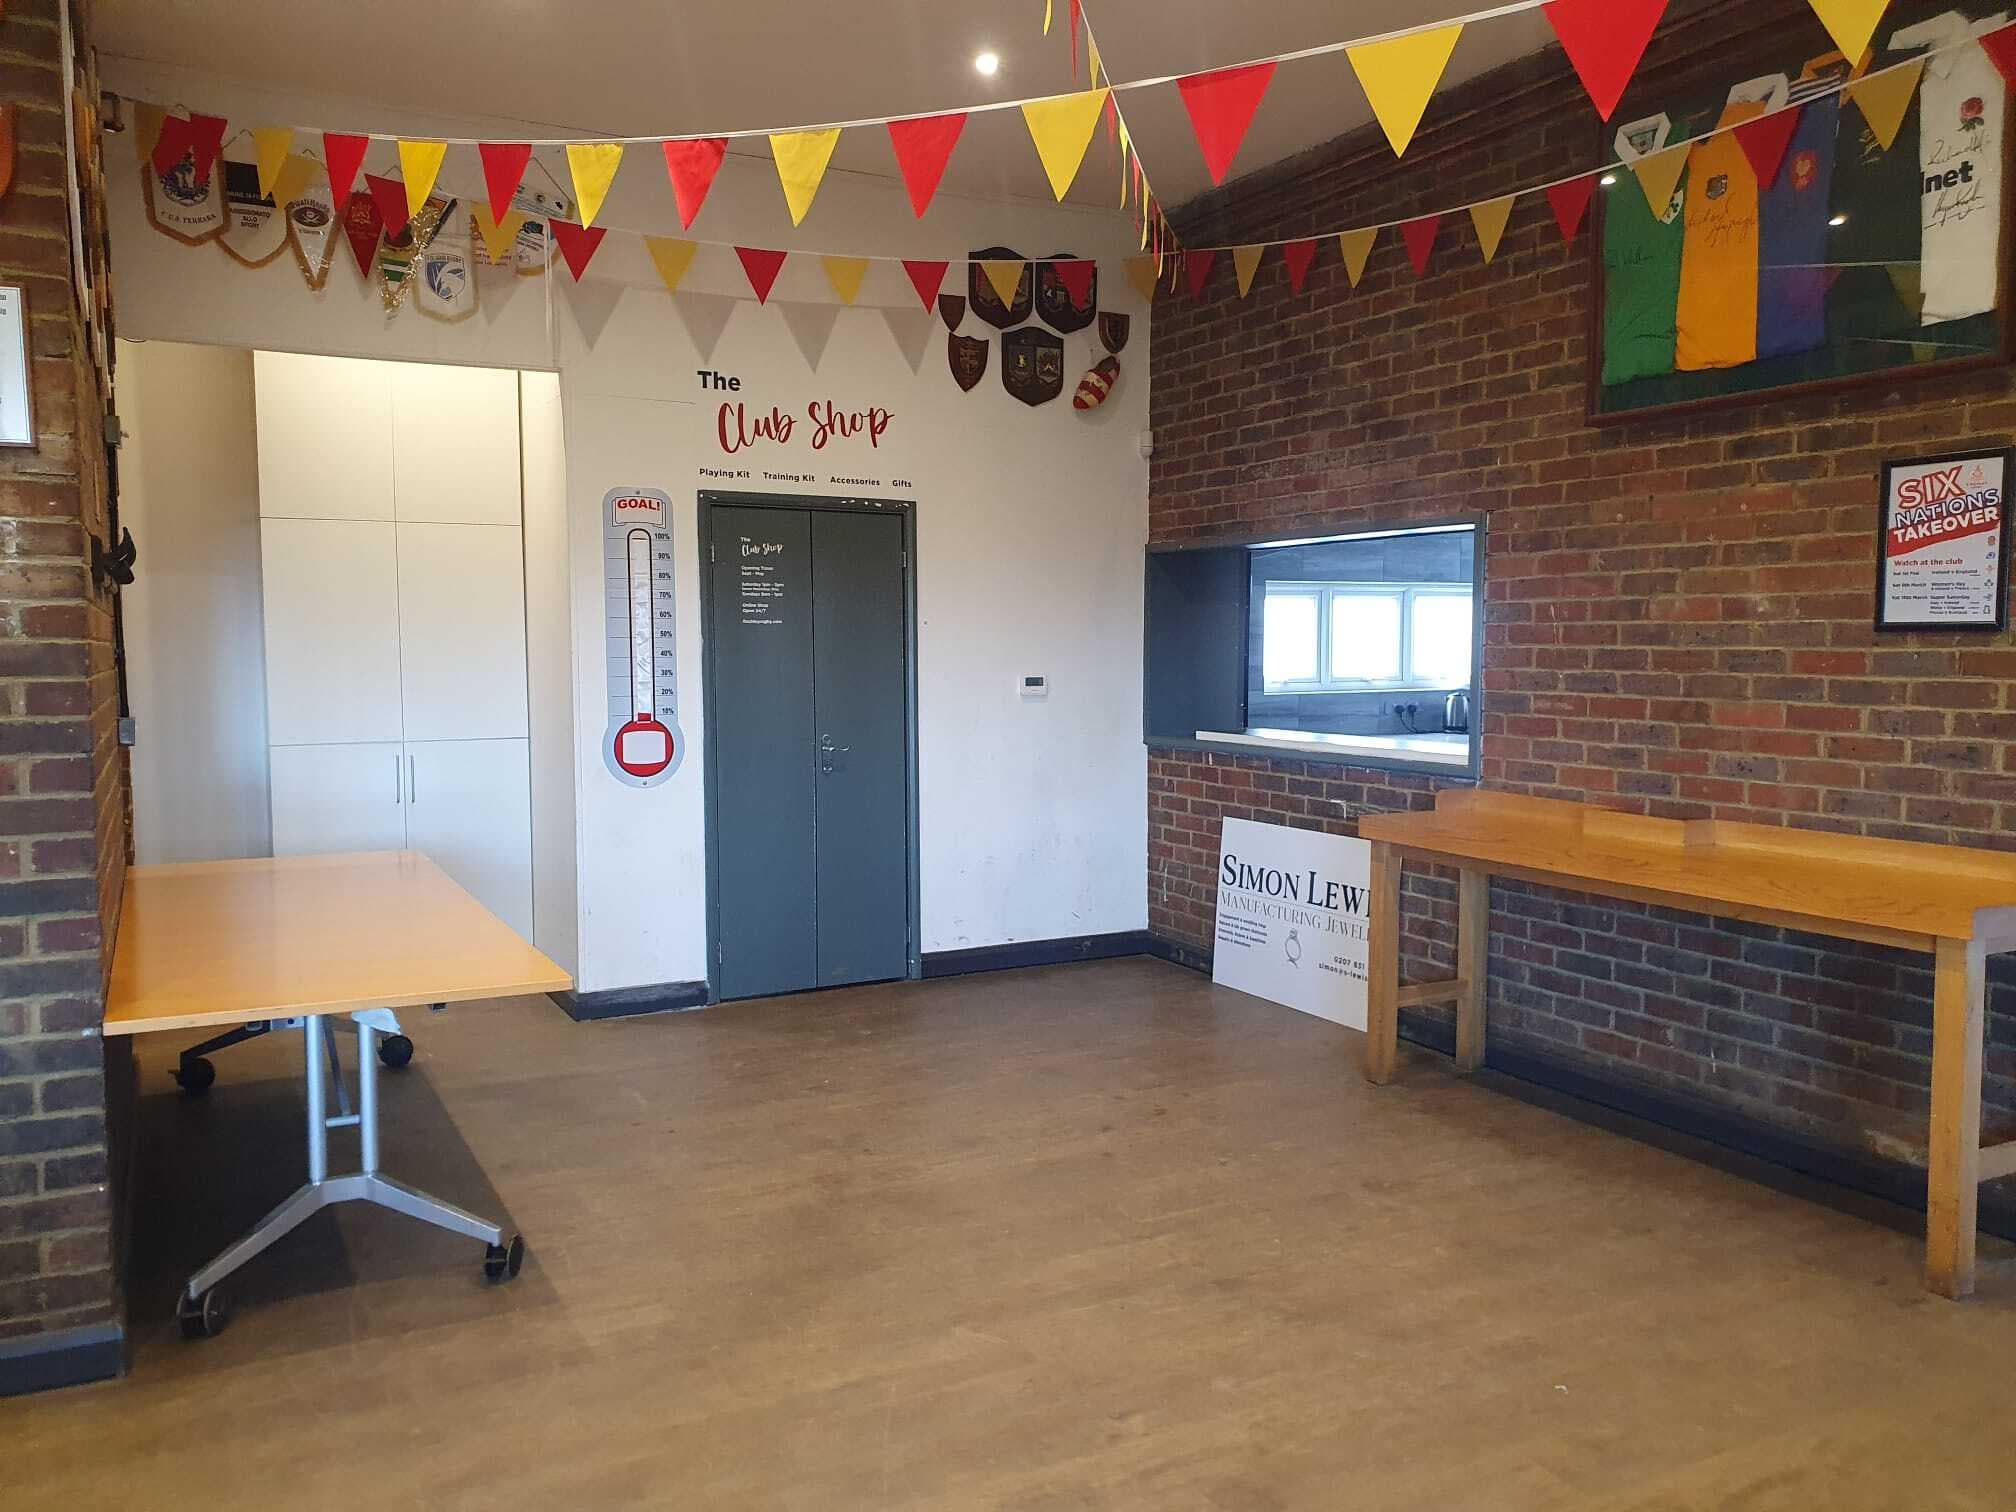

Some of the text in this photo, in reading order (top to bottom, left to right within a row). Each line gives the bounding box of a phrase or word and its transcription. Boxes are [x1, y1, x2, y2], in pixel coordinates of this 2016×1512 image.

[697, 370, 742, 392] The
[718, 400, 895, 454] Club Shop
[699, 468, 912, 488] Playing Kit Training Kit Accessories Gifts
[1898, 464, 1967, 510] SIX
[617, 498, 660, 511] GOAL!
[1895, 487, 2000, 528] NATIONS
[1893, 506, 2000, 543] TAKEOVER
[654, 532, 670, 540] 100%
[658, 552, 670, 560] 90%
[741, 543, 784, 557] Club Shop
[1894, 558, 1963, 567] Watch at the club
[1222, 854, 1300, 900] SIMON
[1220, 890, 1321, 928] MANUFACTURING
